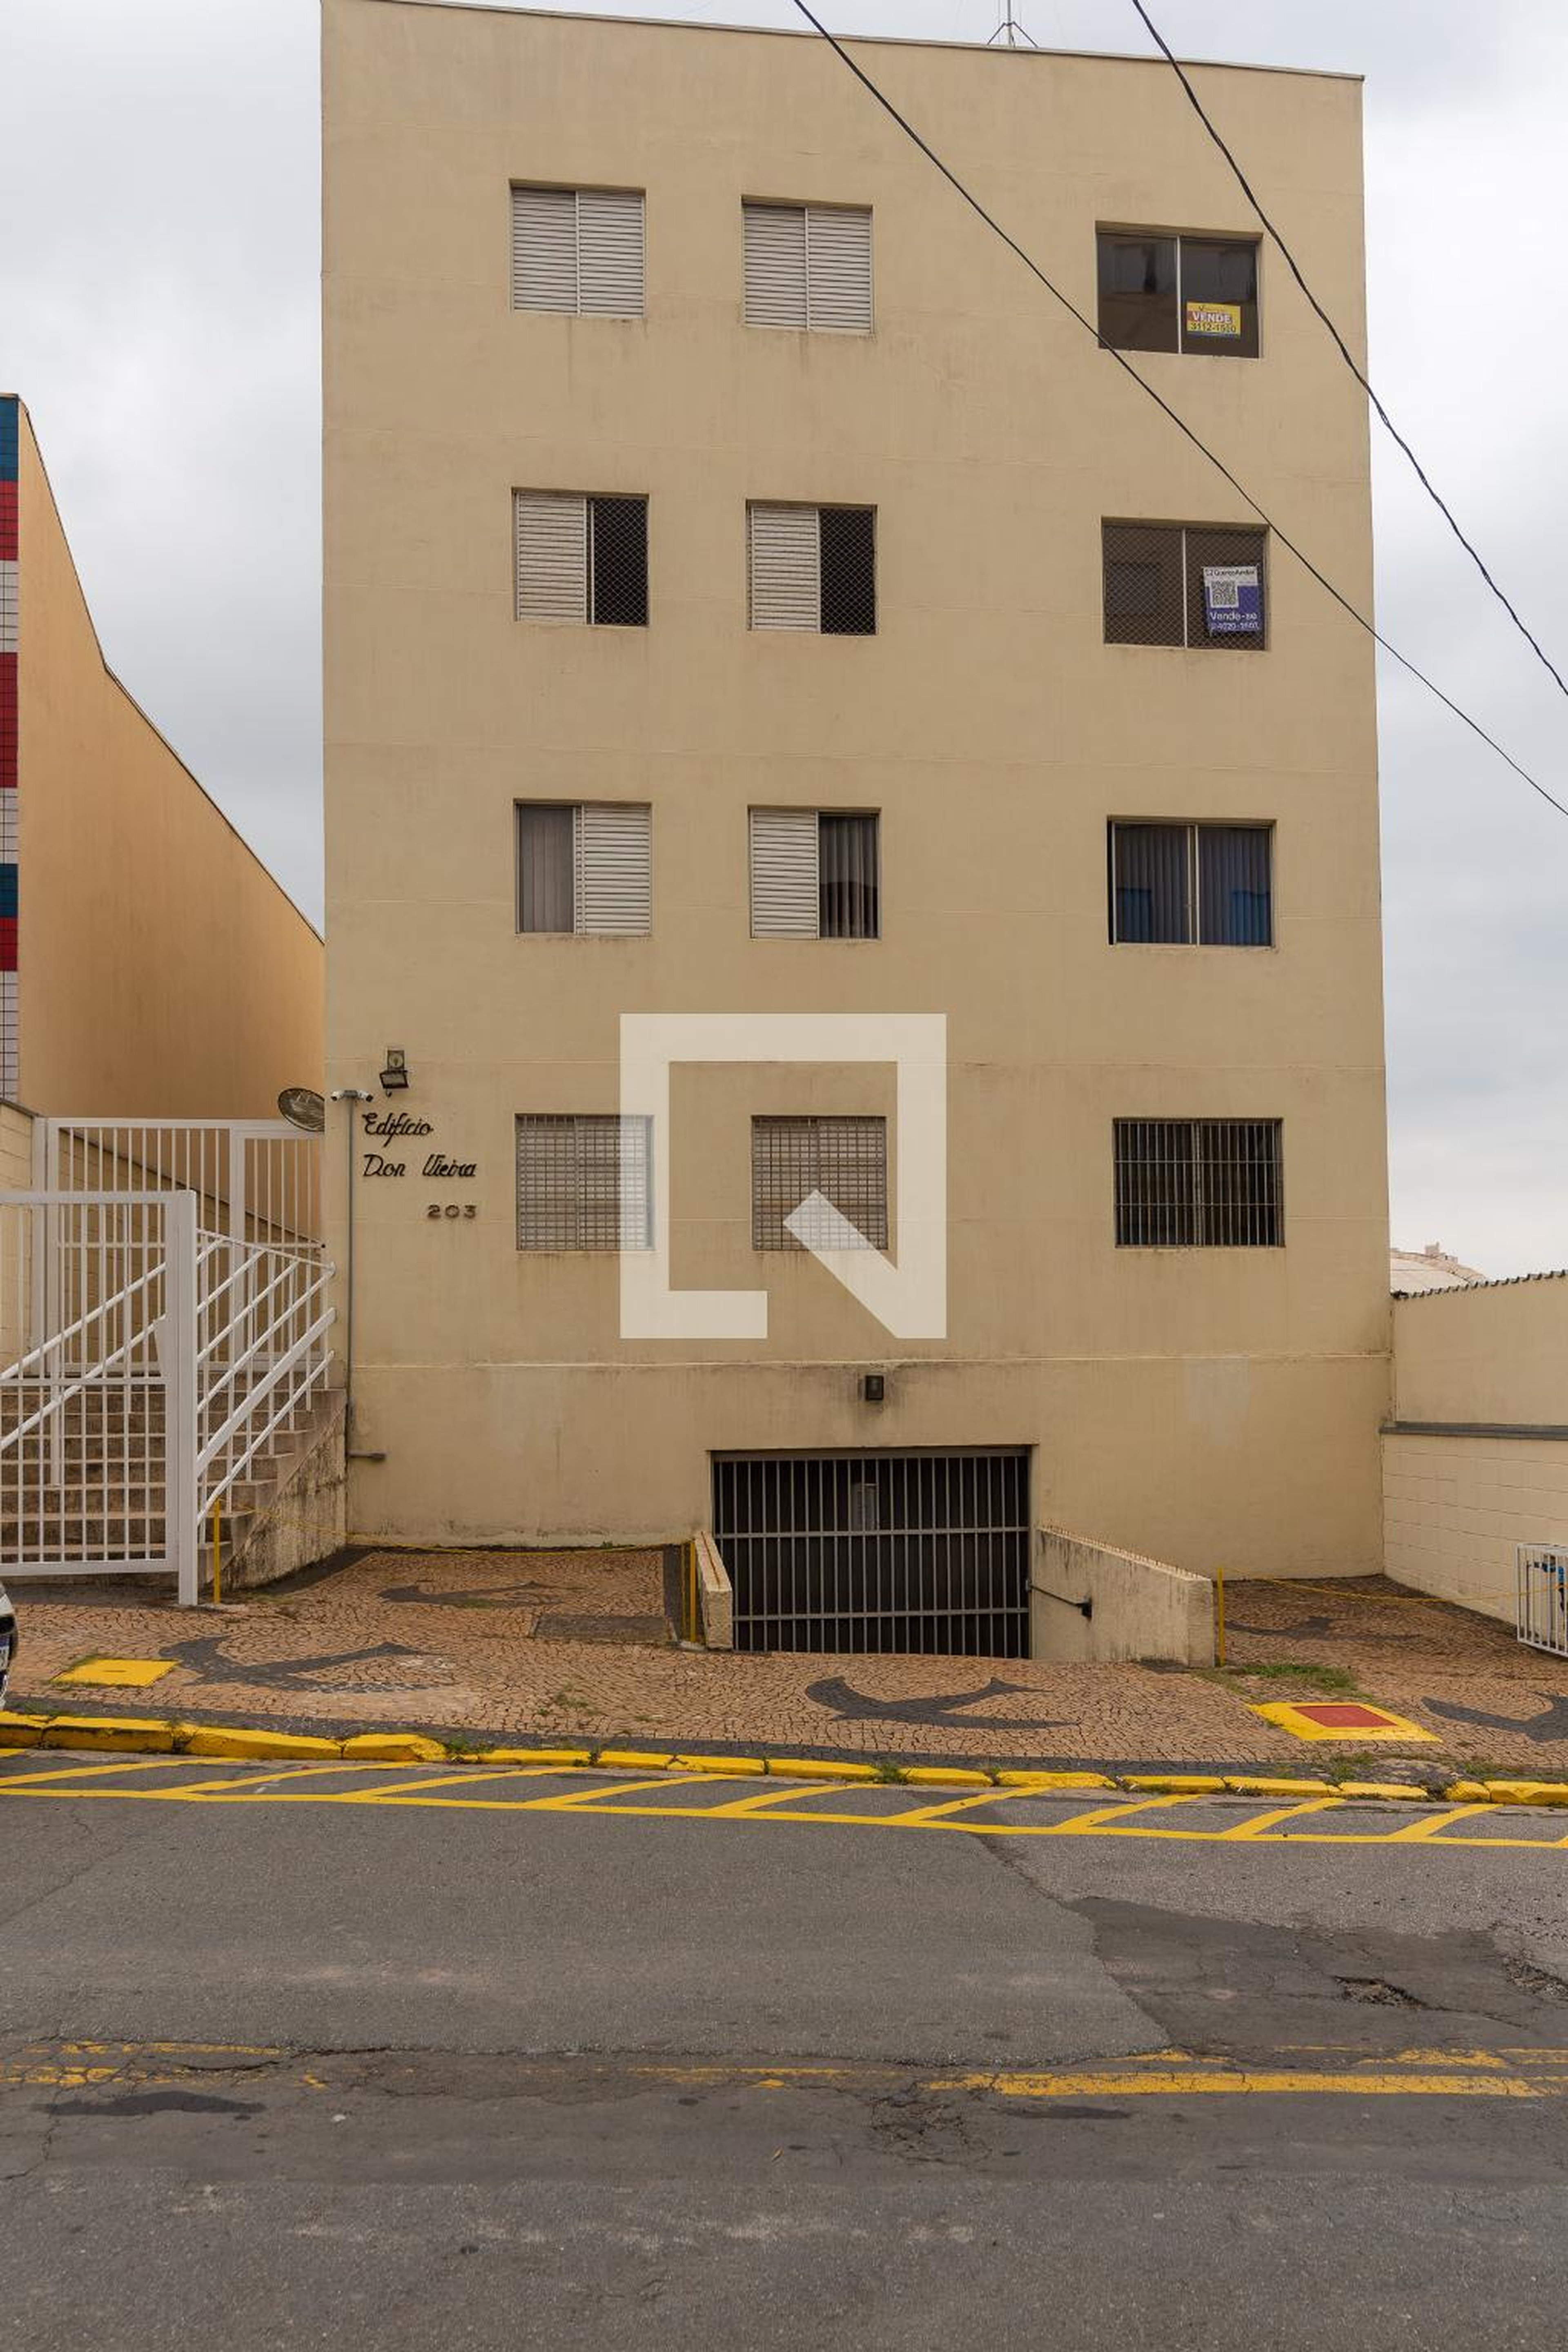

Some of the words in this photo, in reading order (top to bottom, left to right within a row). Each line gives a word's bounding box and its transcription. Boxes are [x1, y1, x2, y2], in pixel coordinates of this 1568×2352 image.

[1192, 312, 1232, 323] VENDE
[1209, 612, 1257, 621] Vende-se
[363, 1154, 405, 1176] Don
[422, 1154, 477, 1177] Vieira
[427, 1205, 477, 1219] 203
